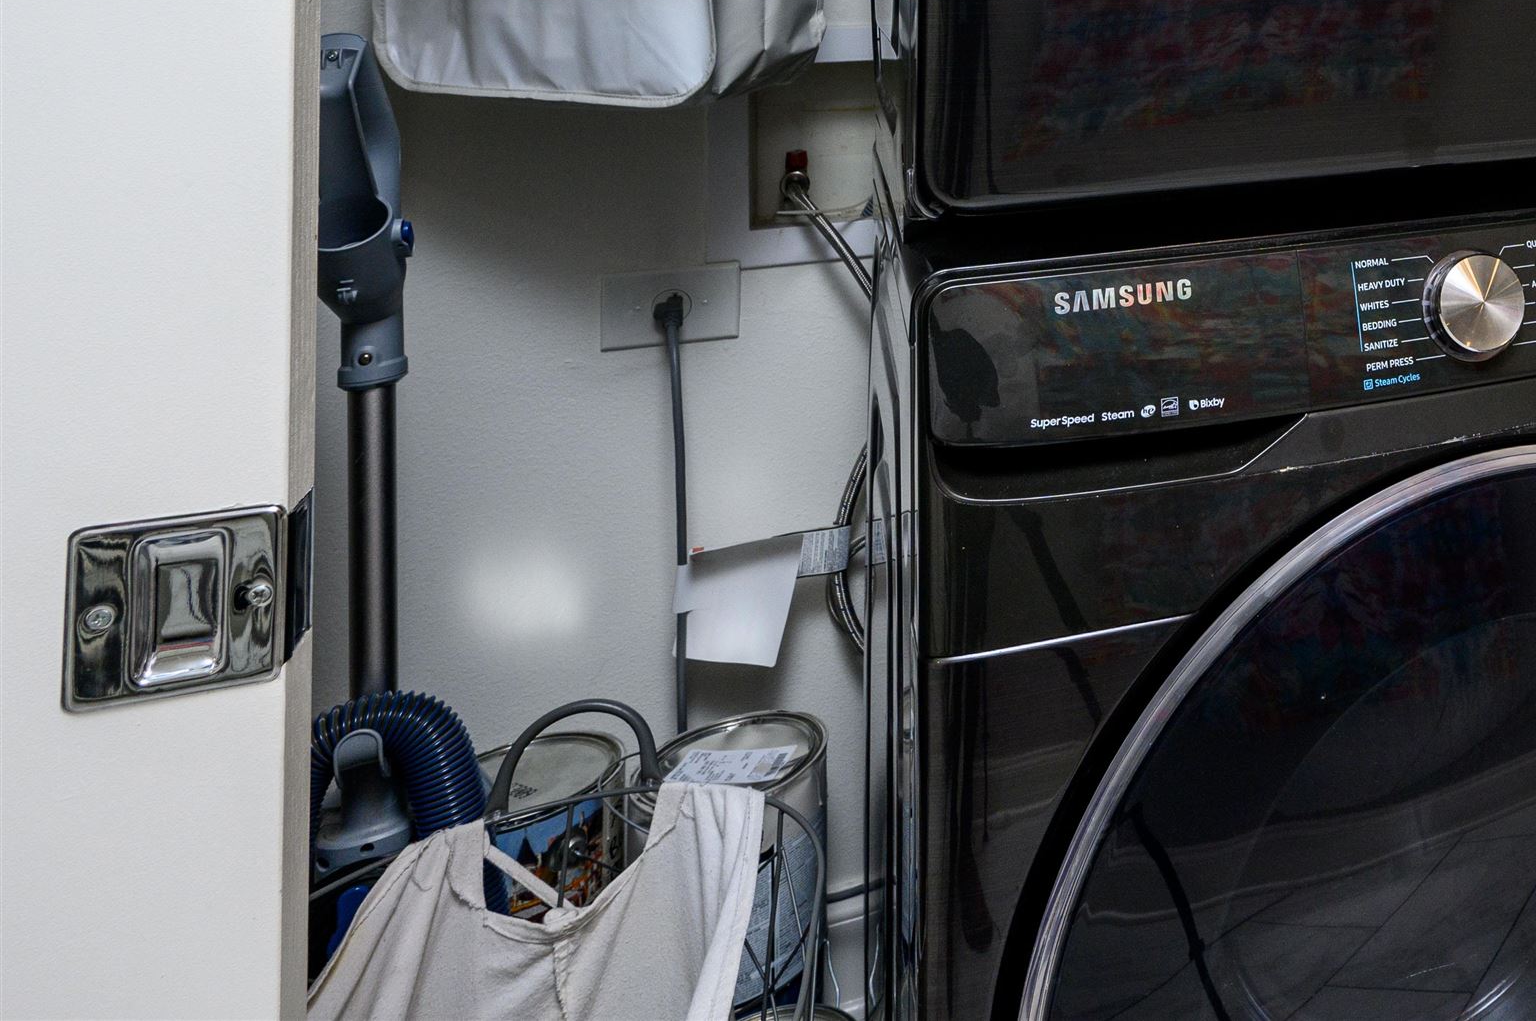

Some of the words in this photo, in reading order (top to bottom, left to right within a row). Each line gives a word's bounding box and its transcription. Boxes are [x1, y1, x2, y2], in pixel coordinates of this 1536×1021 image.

[1355, 258, 1389, 269] NORMAL
[1358, 281, 1383, 291] HEAVY
[1385, 278, 1405, 288] DUTY
[1054, 278, 1193, 315] SAMSUNG
[1360, 300, 1389, 311] WHITES
[1362, 319, 1397, 332] BEDDING
[1364, 339, 1398, 352] SANITIZE
[1366, 360, 1388, 372] PERM
[1390, 357, 1414, 368] PRESS
[1375, 377, 1397, 388] Steam
[1398, 373, 1420, 384] Cycles
[1101, 408, 1135, 422] Steam
[1200, 397, 1225, 409] Bixby
